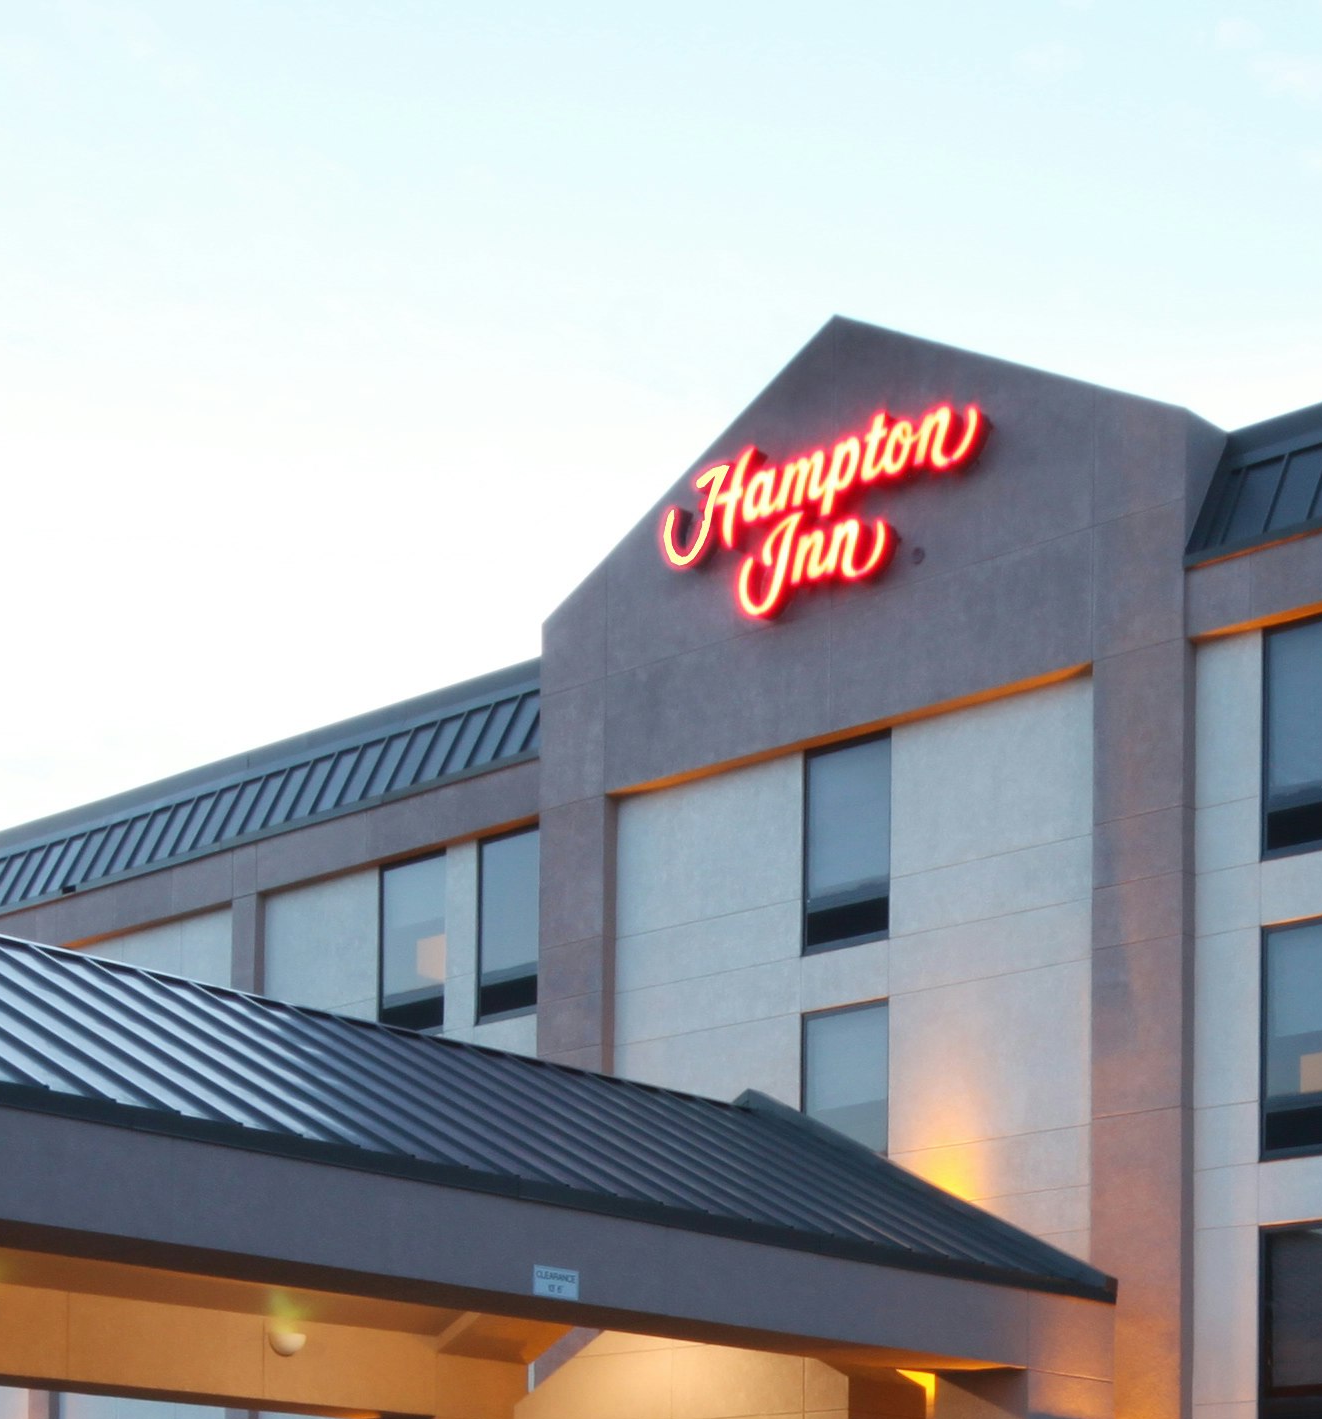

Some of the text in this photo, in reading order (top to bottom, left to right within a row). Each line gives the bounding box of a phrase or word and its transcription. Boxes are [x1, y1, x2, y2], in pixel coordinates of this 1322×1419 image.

[661, 403, 982, 568] Hampton
[736, 509, 887, 617] Inn
[536, 1270, 576, 1284] CLEARANCE
